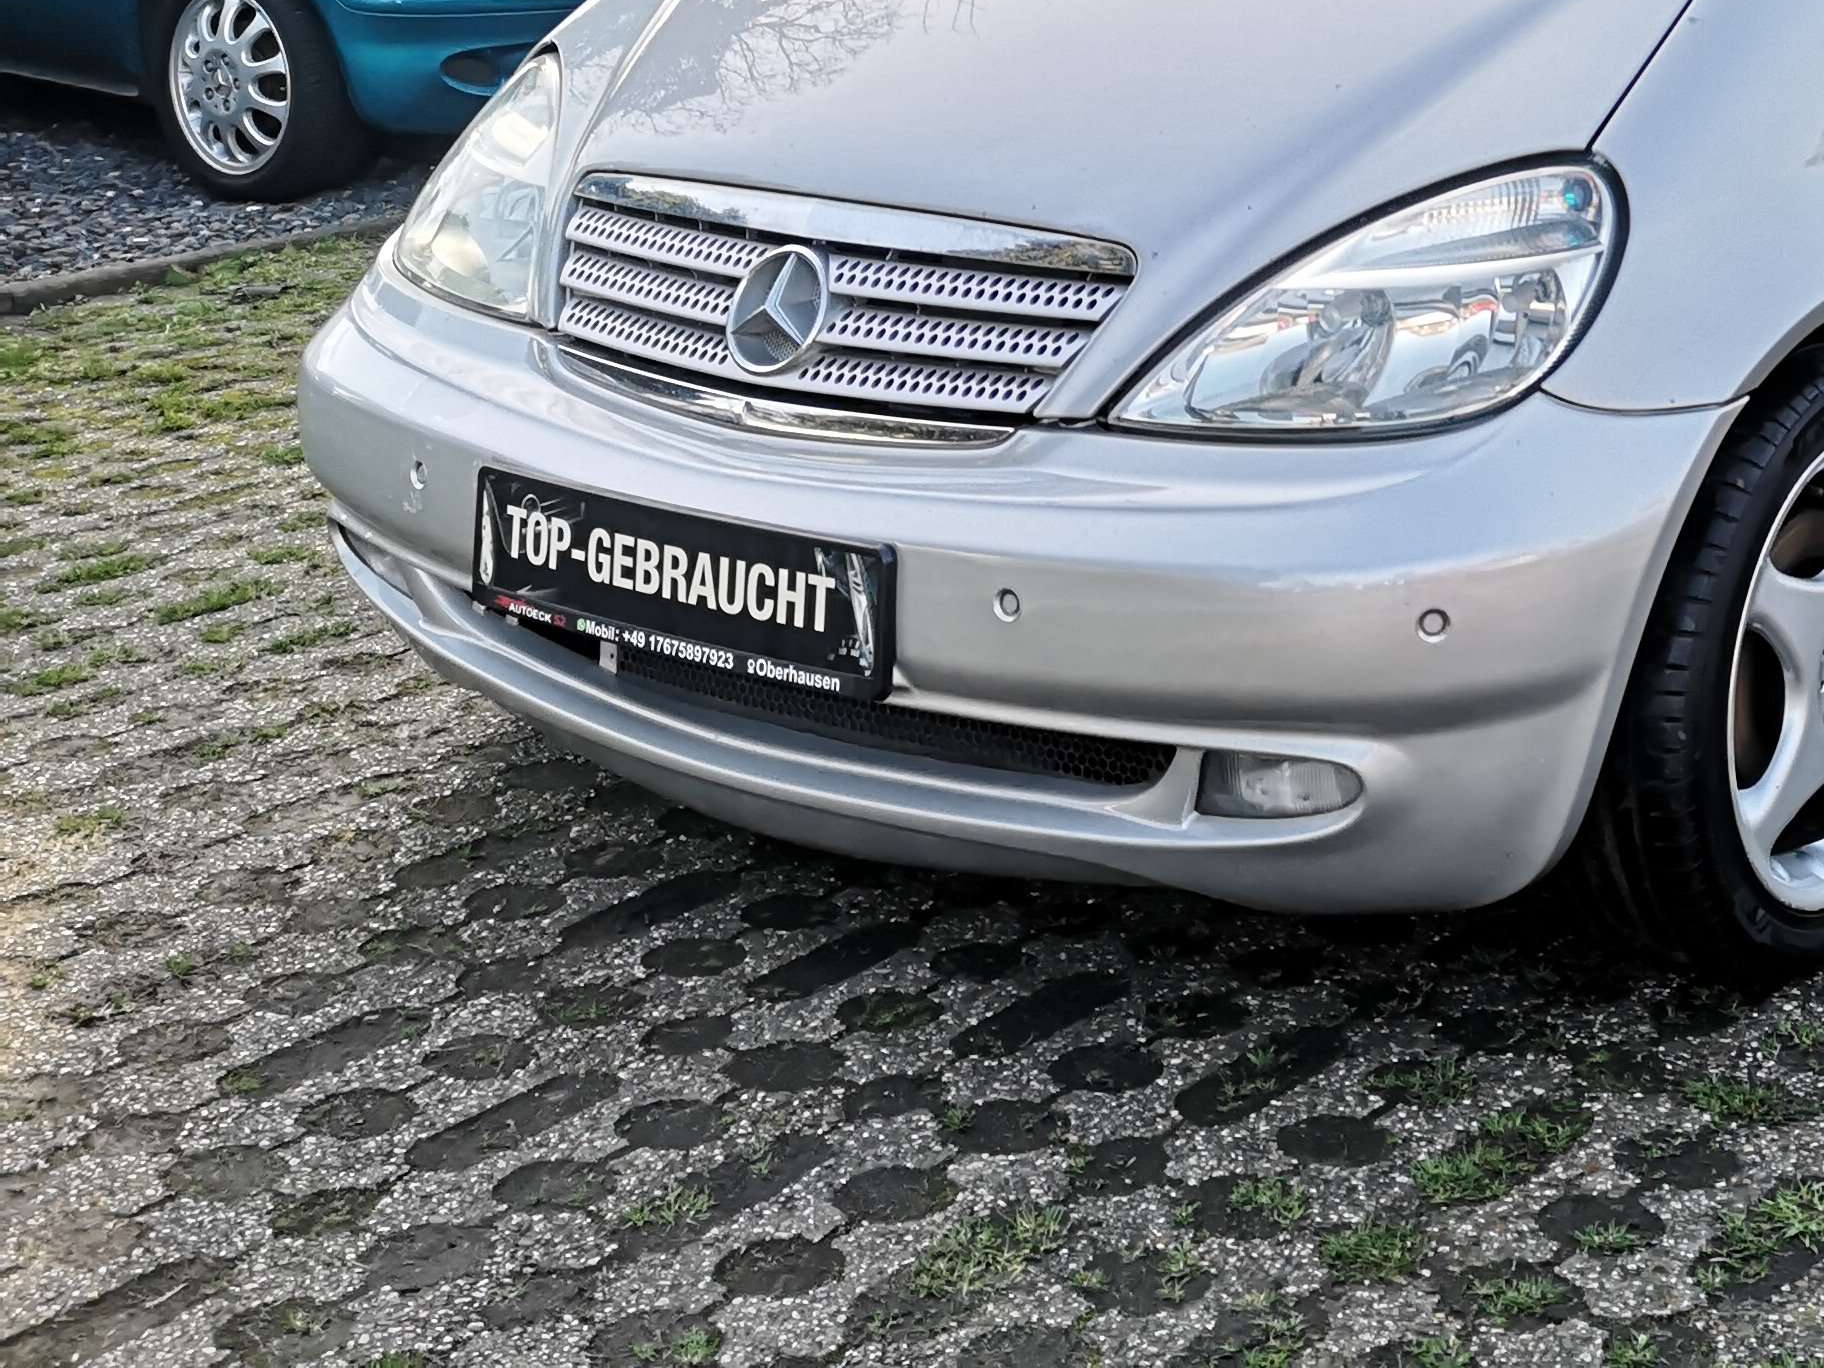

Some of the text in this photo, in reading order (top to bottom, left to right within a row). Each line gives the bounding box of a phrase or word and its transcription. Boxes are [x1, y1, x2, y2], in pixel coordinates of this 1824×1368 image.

[506, 504, 836, 632] TOP-GEBRAUCHT
[508, 603, 552, 624] AUTOECK
[586, 619, 734, 670] Mobil: +49 17675897923
[756, 658, 841, 692] Oberhausen
